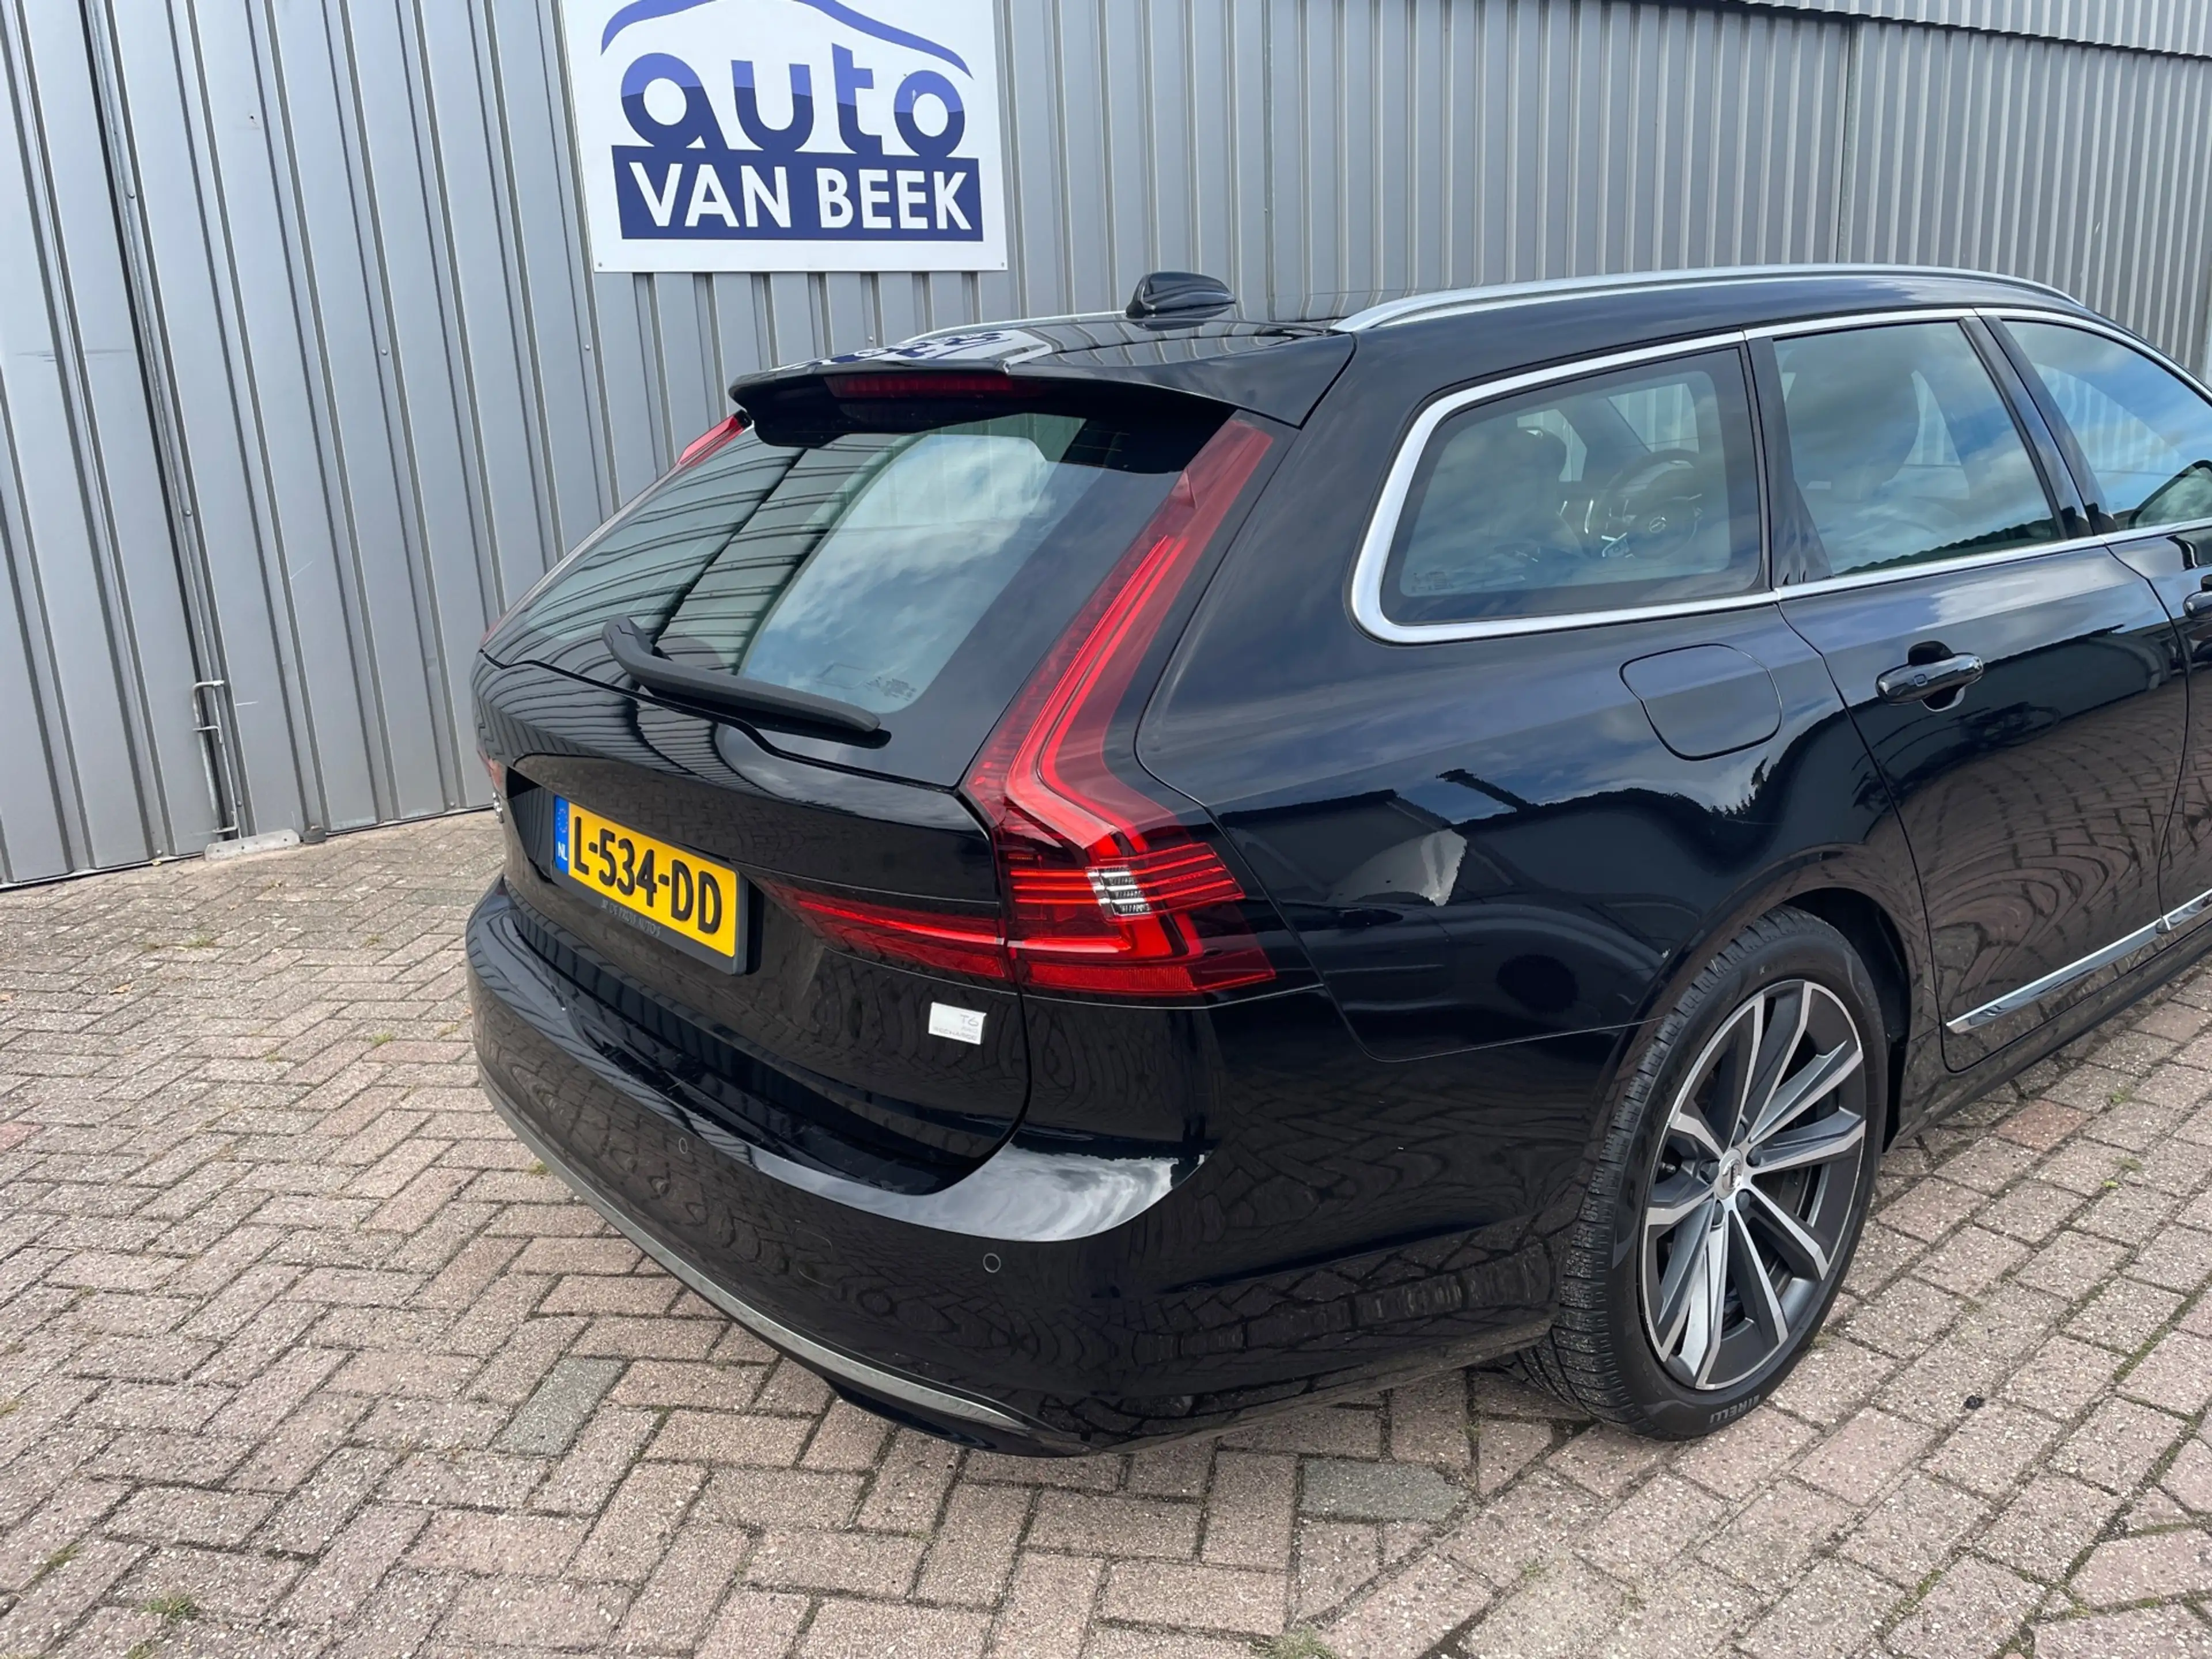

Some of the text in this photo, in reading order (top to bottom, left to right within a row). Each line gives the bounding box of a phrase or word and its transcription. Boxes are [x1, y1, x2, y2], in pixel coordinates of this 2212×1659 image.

[621, 43, 965, 157] auto
[628, 162, 972, 230] VAN BEEK
[557, 842, 567, 861] NL
[574, 816, 722, 935] L-534-DD
[960, 1014, 979, 1027] T6
